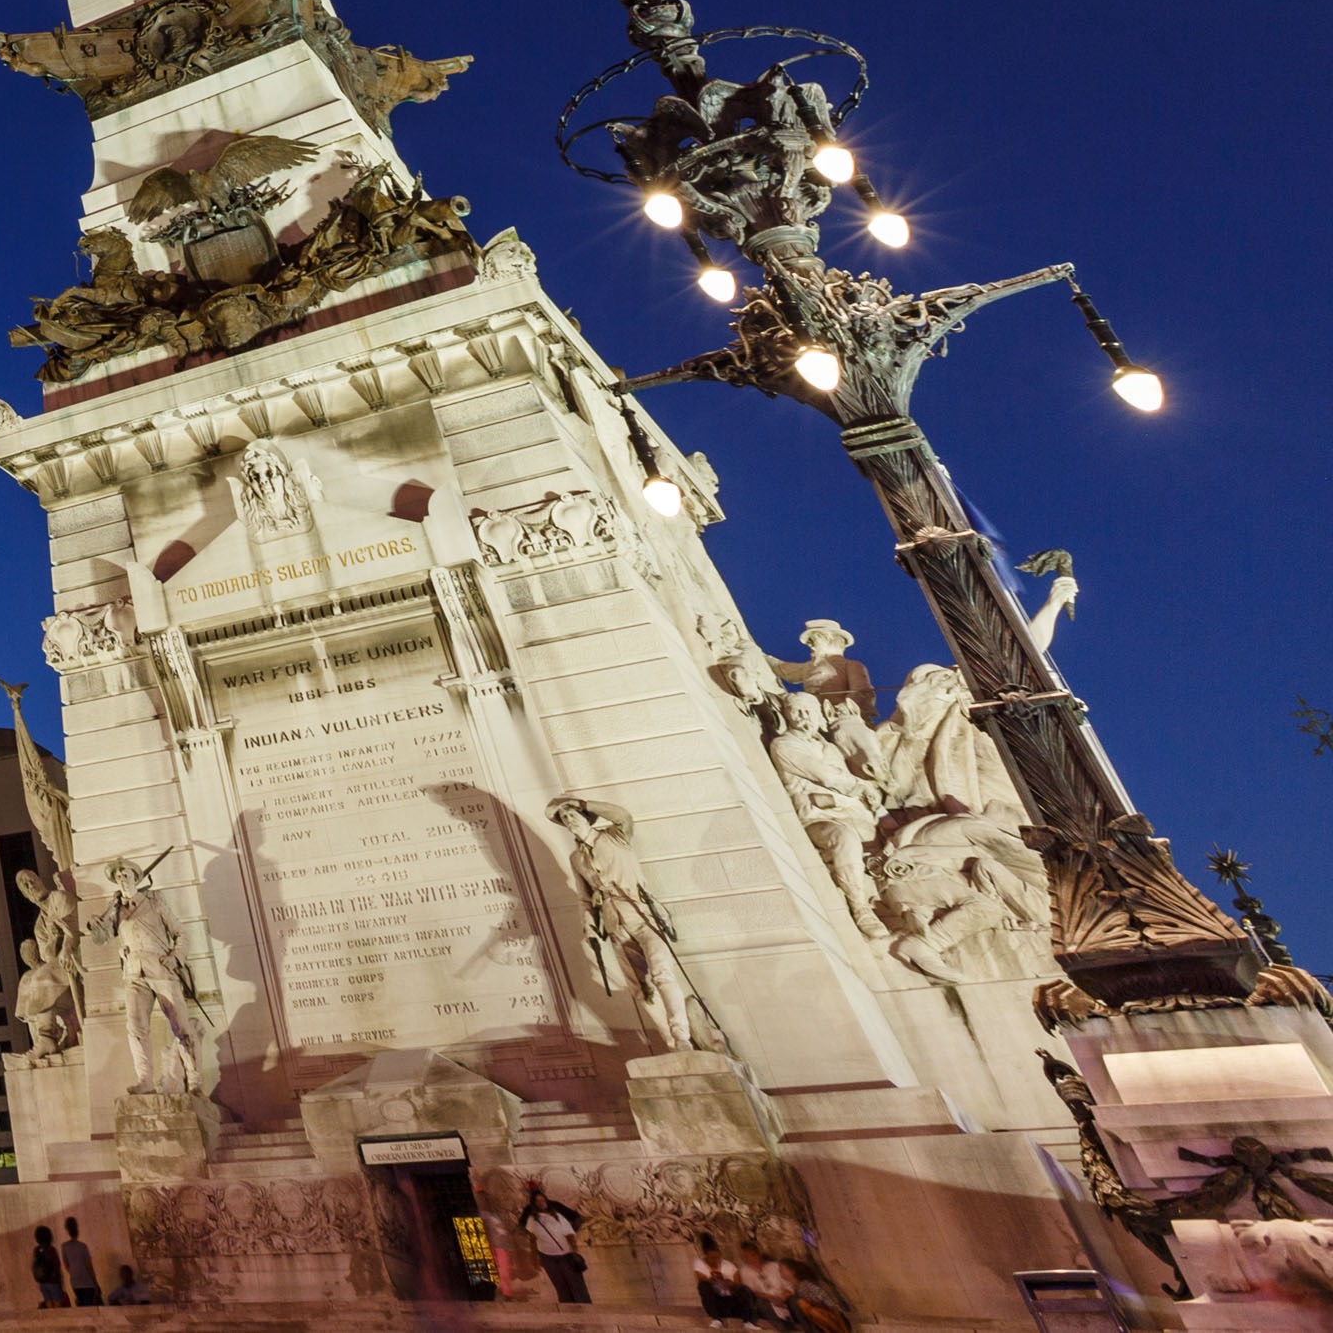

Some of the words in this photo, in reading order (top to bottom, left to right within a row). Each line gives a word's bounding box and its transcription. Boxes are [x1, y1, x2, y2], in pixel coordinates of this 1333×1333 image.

[176, 587, 198, 604] TO
[201, 569, 273, 601] INDIANA'S
[276, 556, 332, 581] SILENT
[338, 537, 416, 568] VICTORS.
[223, 670, 265, 689] WAR
[272, 660, 312, 680] FOR
[318, 652, 361, 669] THE
[367, 636, 434, 661] UNION
[244, 727, 315, 749] INDIANA
[321, 703, 444, 735] VOLUNTEERS
[266, 753, 332, 771] REGIMENTS
[338, 741, 395, 759] INFANTRY
[413, 730, 462, 745] 175772
[269, 766, 335, 784] REGIMENTS
[342, 756, 395, 772] CAVALRY
[274, 789, 333, 806] REGIMENT
[346, 776, 414, 795] ARTILLERY
[277, 802, 345, 820] COMPANIES
[358, 787, 427, 807] ARTILLERY
[282, 830, 312, 842] NAVY
[359, 831, 410, 847] TOTAL
[263, 868, 306, 882] KILLED
[314, 864, 337, 874] AND
[271, 901, 327, 922] INDIANA
[329, 899, 345, 914] IN
[349, 894, 377, 912] THE
[380, 890, 413, 907] WAR
[416, 884, 457, 903] WITH
[460, 877, 512, 897] SPAIN.
[288, 922, 349, 938] REGIMENTS
[354, 914, 407, 929] INFANTRY
[291, 941, 341, 955] COLORED
[347, 933, 410, 949] COMPANIES
[416, 925, 471, 941] INFANTRY
[294, 957, 352, 972] BATTERIES
[357, 953, 389, 965] LIGHT
[394, 945, 452, 961] ARTILLERY
[288, 977, 340, 991] ENGINEER
[348, 972, 385, 985] CORPS
[292, 996, 330, 1009] SIGNAL
[340, 992, 375, 1004] CORPS
[434, 1001, 480, 1016] TOTAL
[300, 1035, 324, 1046] DIED
[332, 1033, 343, 1044] IN
[351, 1029, 397, 1042] SERVICE
[371, 1151, 425, 1161] OBSERVATION
[426, 1149, 456, 1158] TOWER
[389, 1143, 408, 1151] GIFT
[410, 1141, 432, 1150] SHOP
